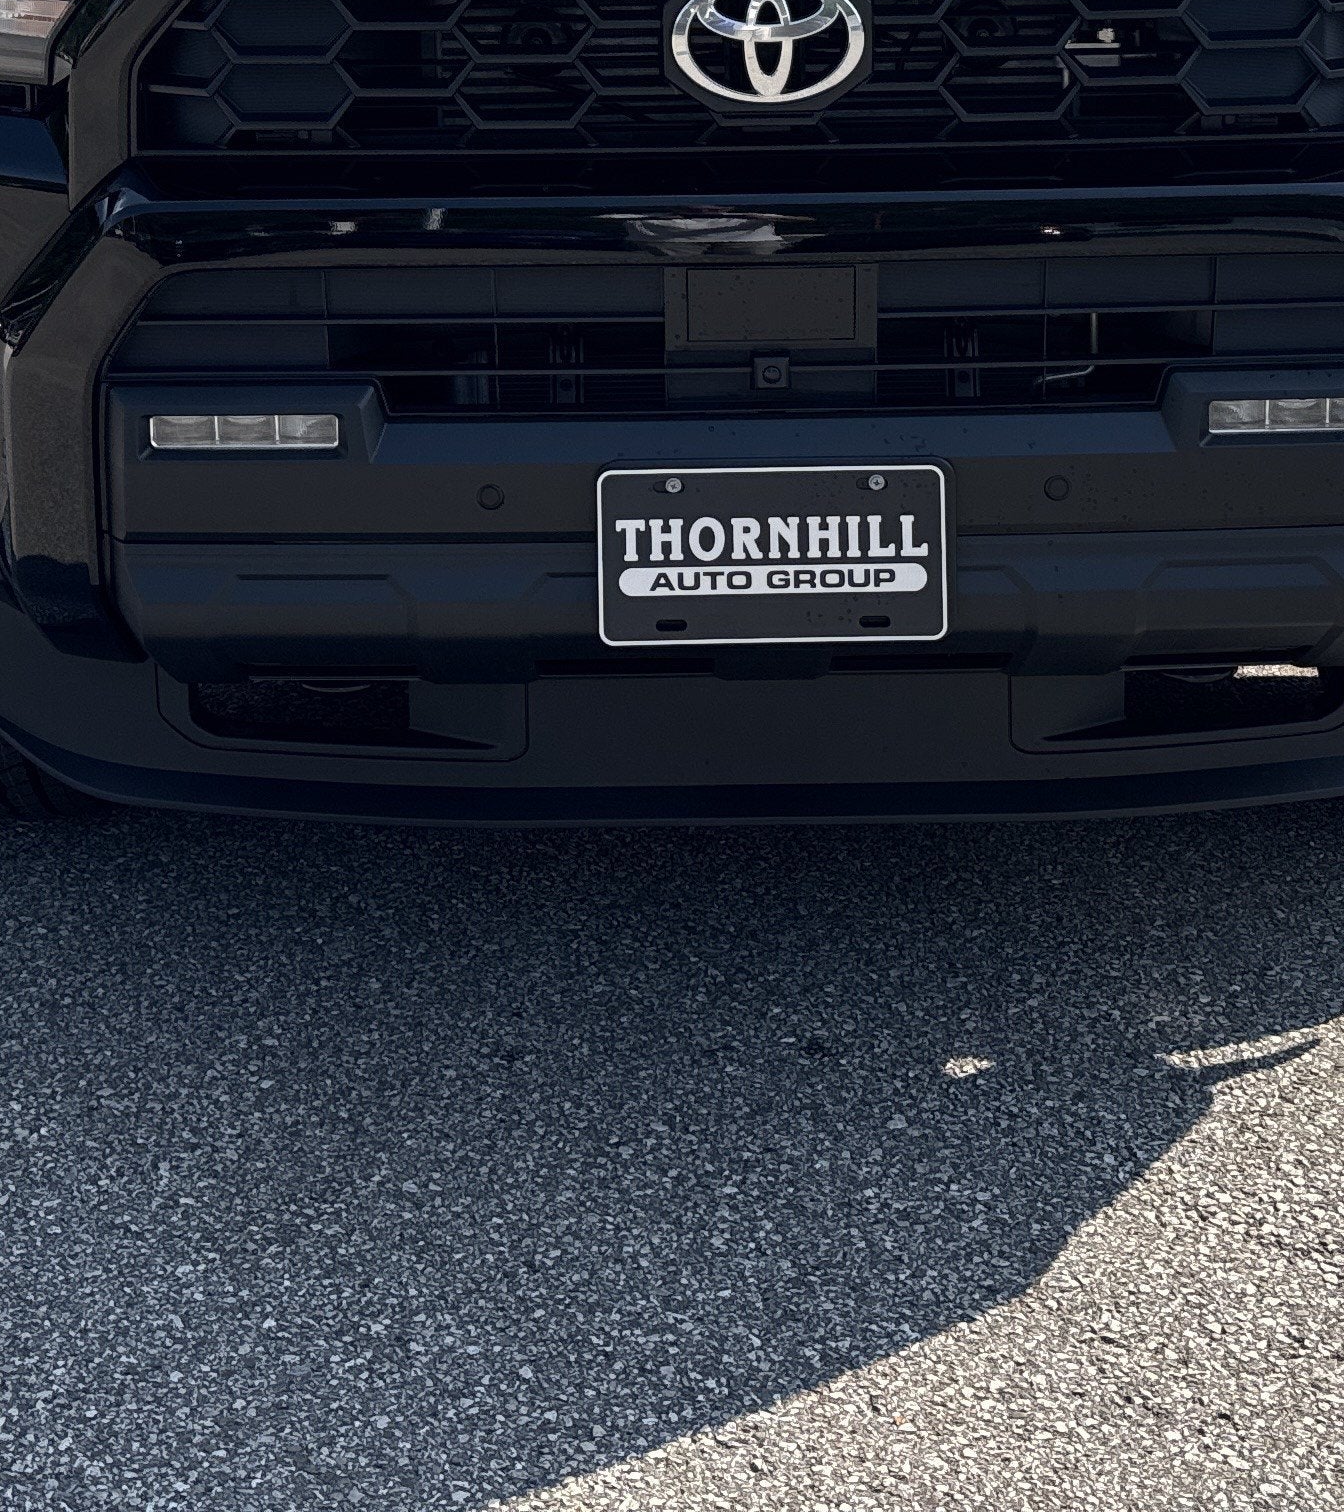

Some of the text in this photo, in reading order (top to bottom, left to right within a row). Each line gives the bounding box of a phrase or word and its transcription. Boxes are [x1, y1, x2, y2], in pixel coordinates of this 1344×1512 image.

[615, 514, 929, 562] THORNHILL
[649, 567, 896, 592] AUTO GROUP
